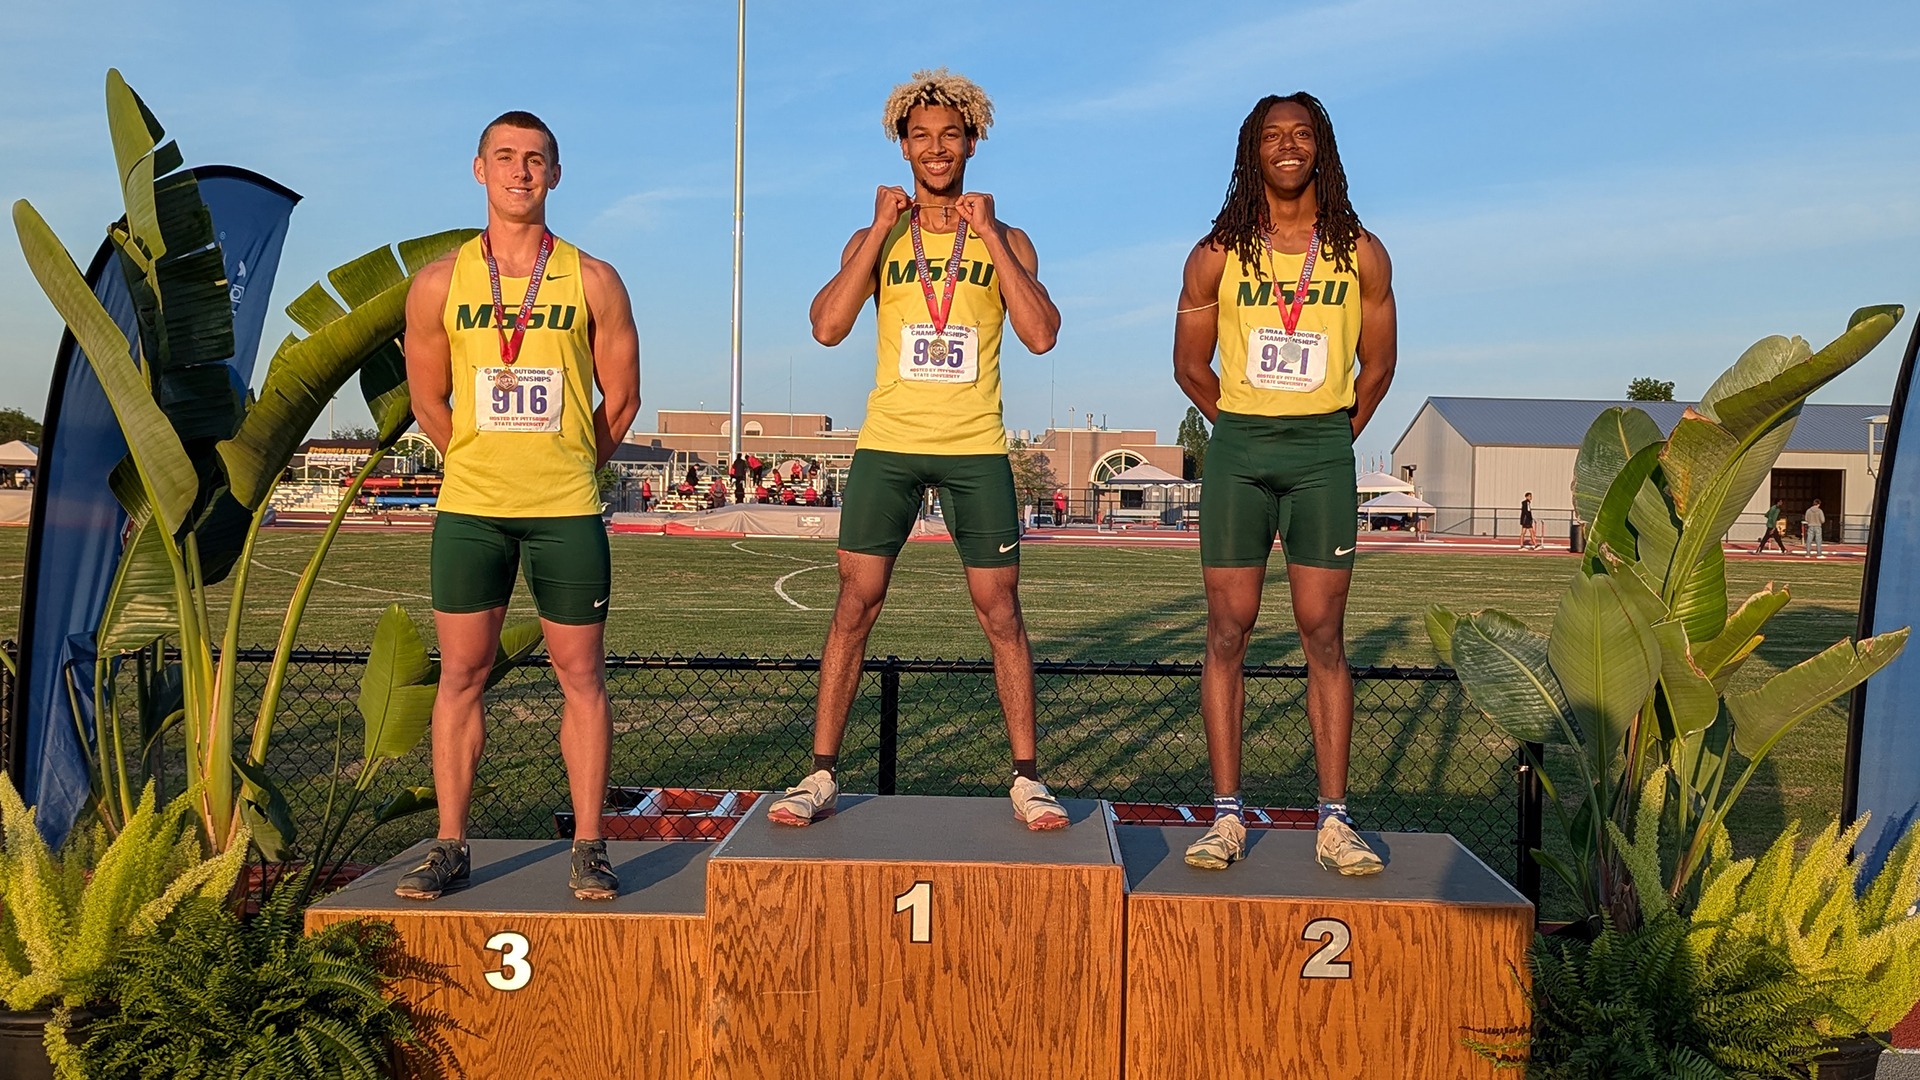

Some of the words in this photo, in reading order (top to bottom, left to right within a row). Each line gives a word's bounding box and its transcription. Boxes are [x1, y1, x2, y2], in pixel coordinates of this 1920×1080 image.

[886, 257, 995, 287] MSSU
[1236, 280, 1349, 306] MSSU
[456, 303, 577, 331] MSSU
[911, 330, 969, 339] CHAMPNSHIPS
[1259, 335, 1318, 346] CHAMPINSHIPS
[492, 384, 547, 415] 916
[893, 880, 935, 945] 1
[482, 929, 534, 993] 3
[1299, 917, 1355, 980] 2
